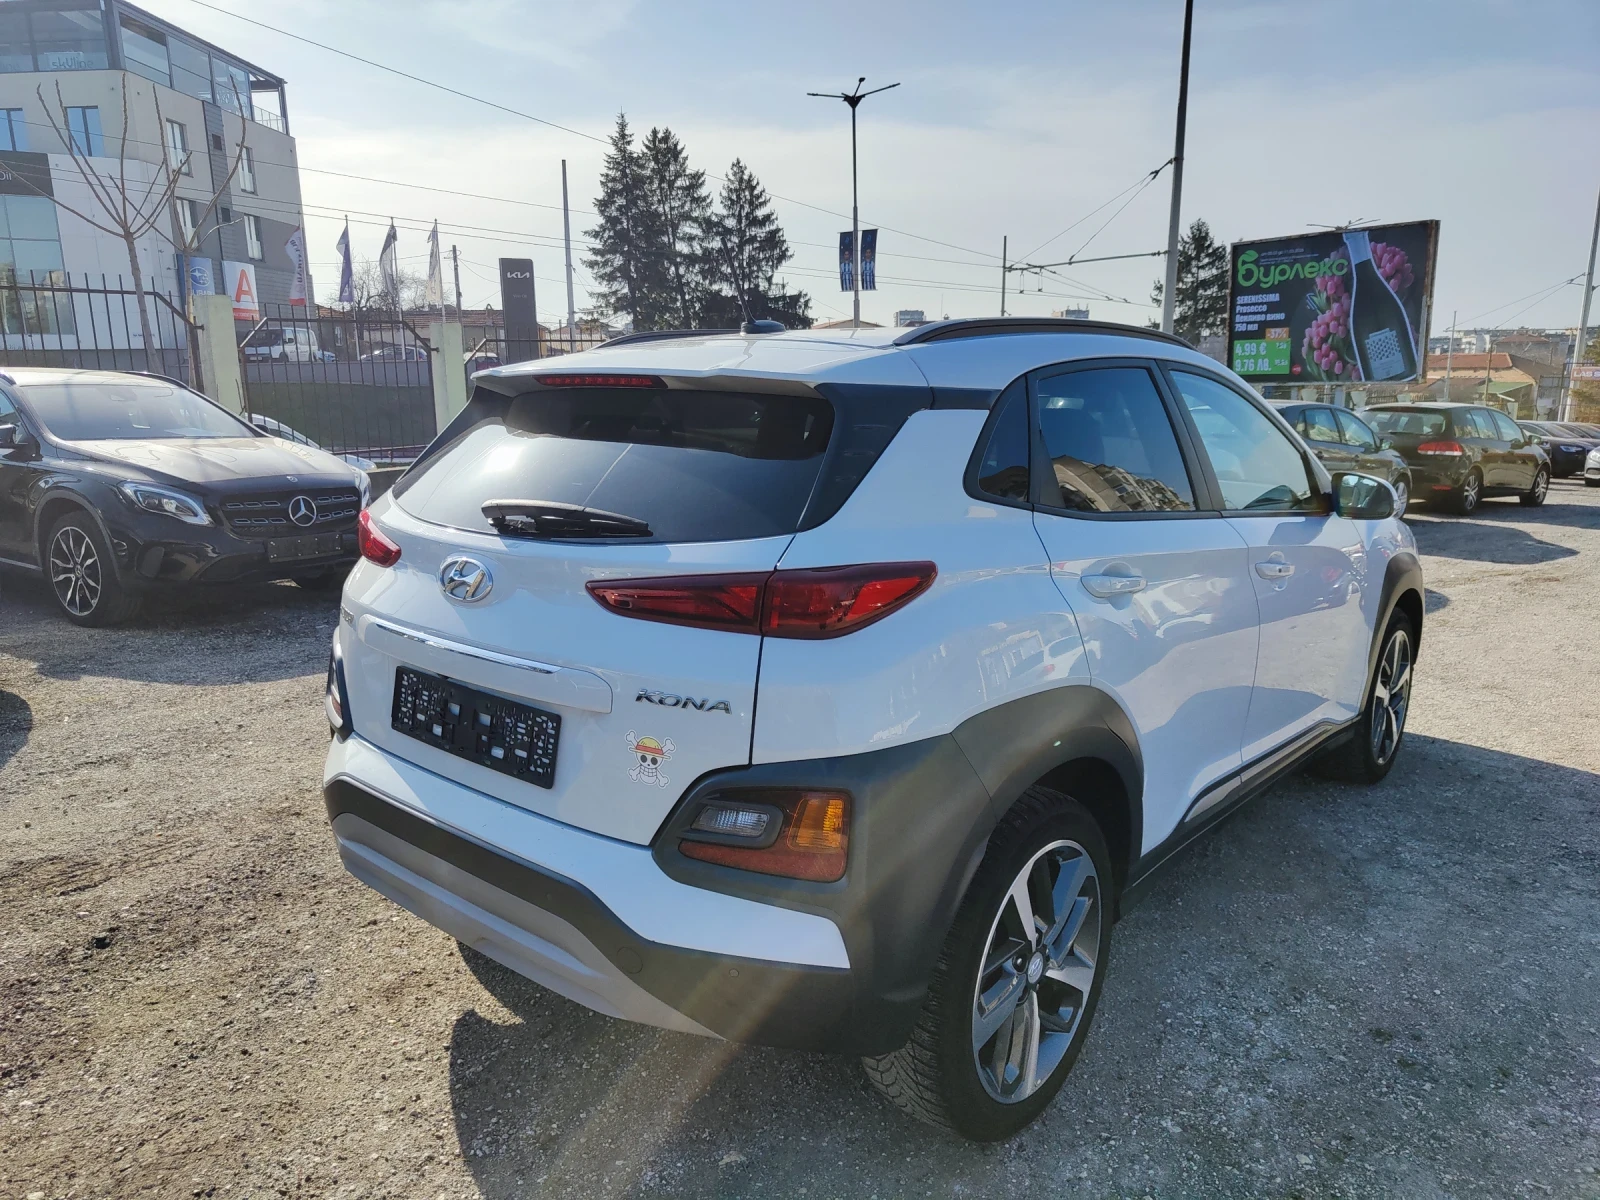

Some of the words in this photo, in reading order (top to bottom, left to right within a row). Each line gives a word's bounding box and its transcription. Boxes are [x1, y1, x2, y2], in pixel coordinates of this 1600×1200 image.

[506, 271, 530, 279] KIA
[1236, 294, 1280, 304] SERENISSIMA
[1236, 305, 1267, 313] Prosecco
[1234, 323, 1246, 332] 750
[1235, 342, 1257, 356] 4.99
[1259, 342, 1267, 355] €
[1235, 358, 1255, 372] 9.76
[635, 688, 733, 715] KONA
